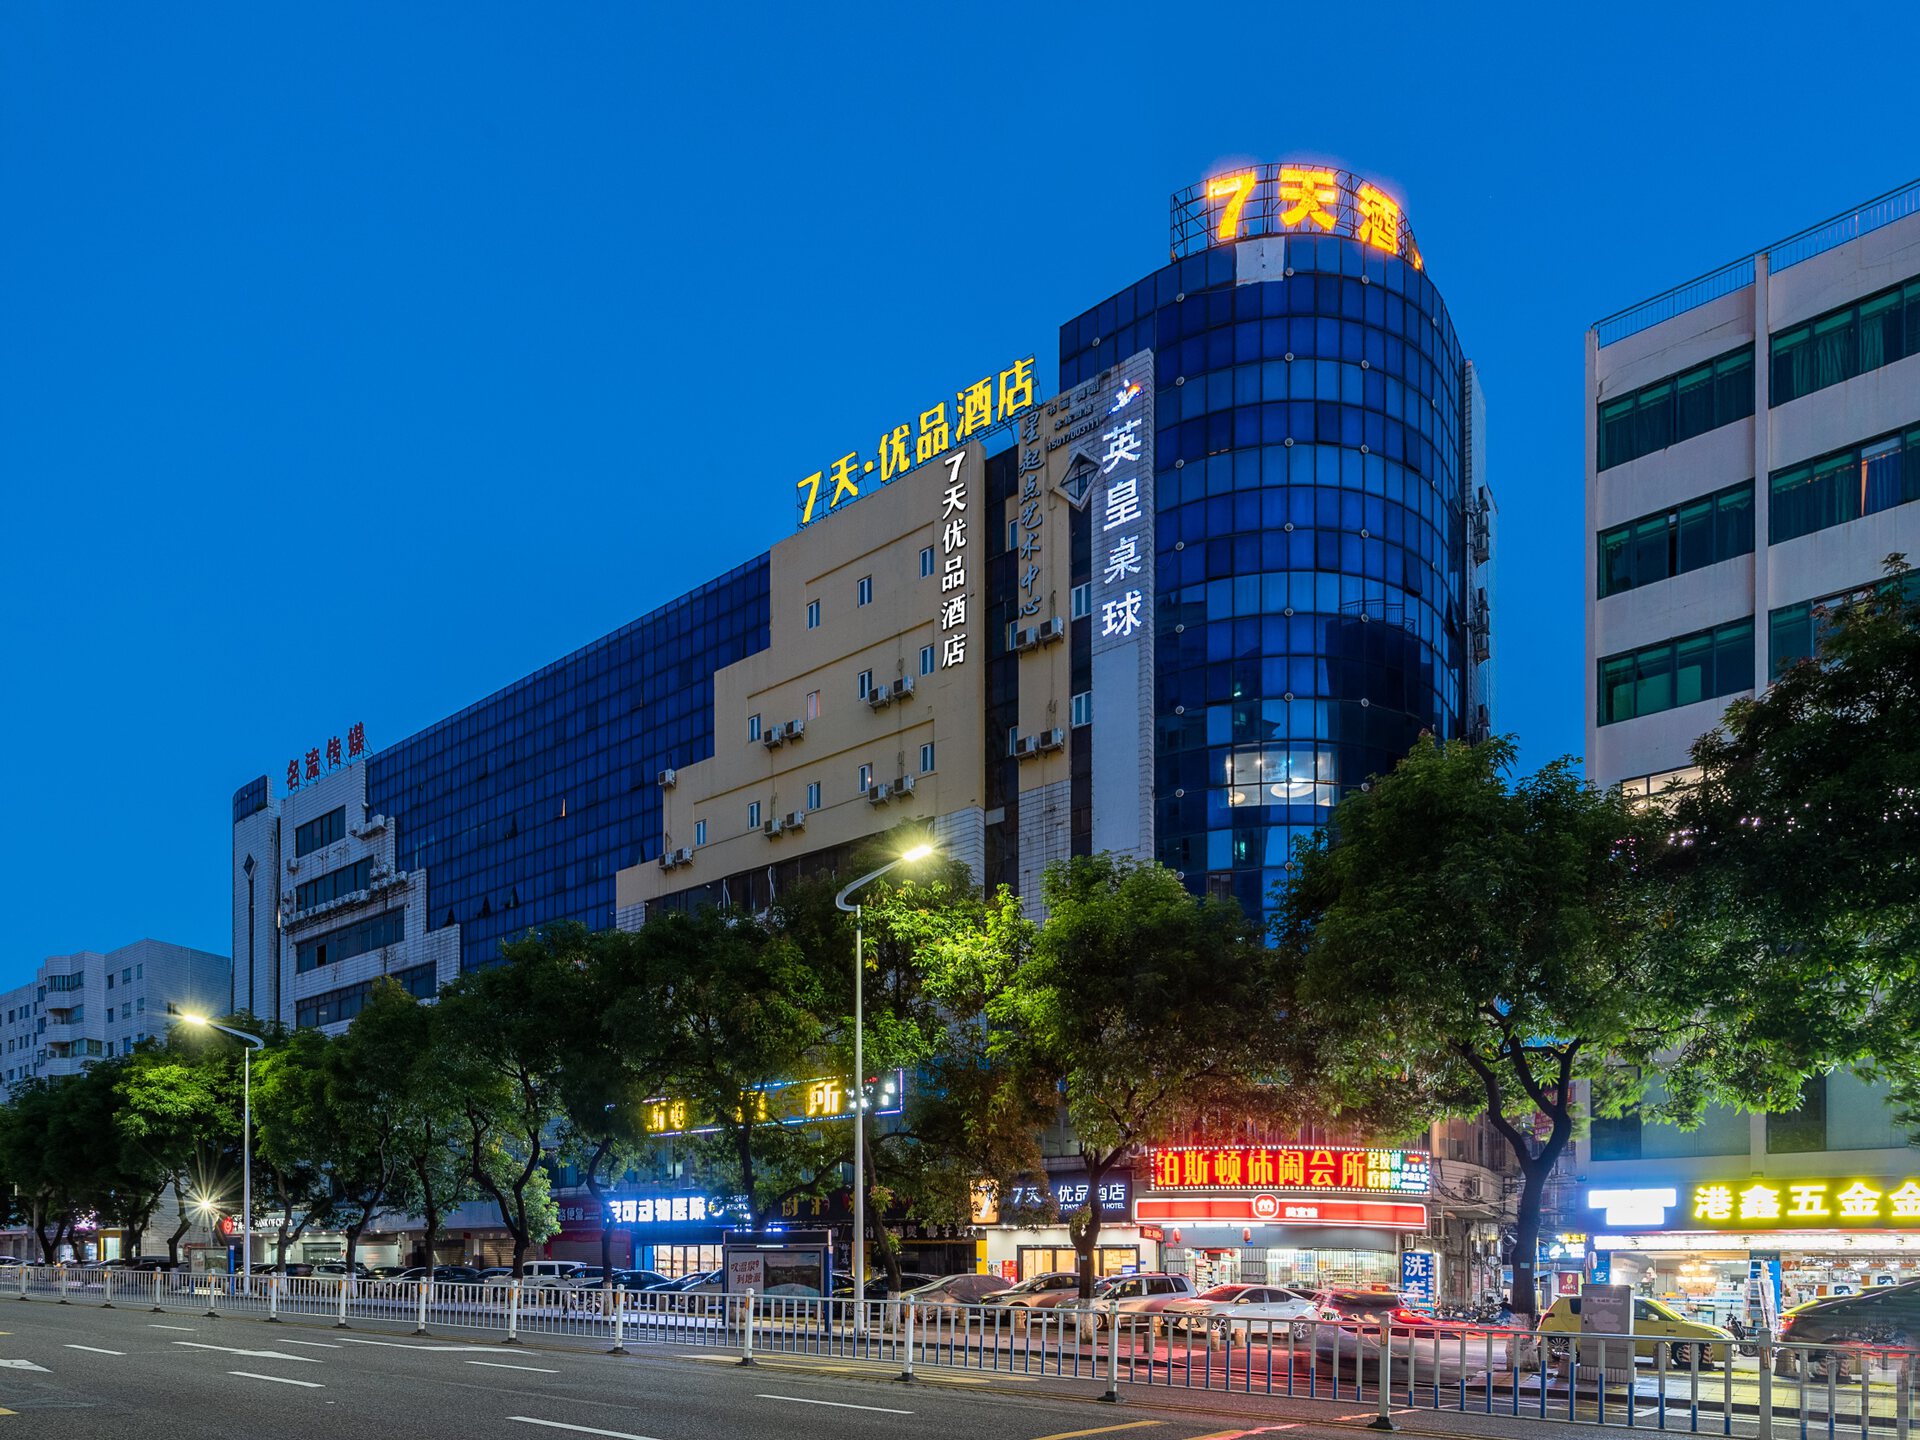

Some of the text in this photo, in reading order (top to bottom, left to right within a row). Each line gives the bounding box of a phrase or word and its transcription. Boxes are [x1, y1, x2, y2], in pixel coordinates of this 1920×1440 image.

[1206, 167, 1422, 270] 7天酒
[797, 357, 1035, 524] 7天·优品酒店
[941, 451, 968, 669] 7天优品酒店
[1102, 418, 1142, 637] 英皇桌球
[1404, 1255, 1427, 1299] 洗车
